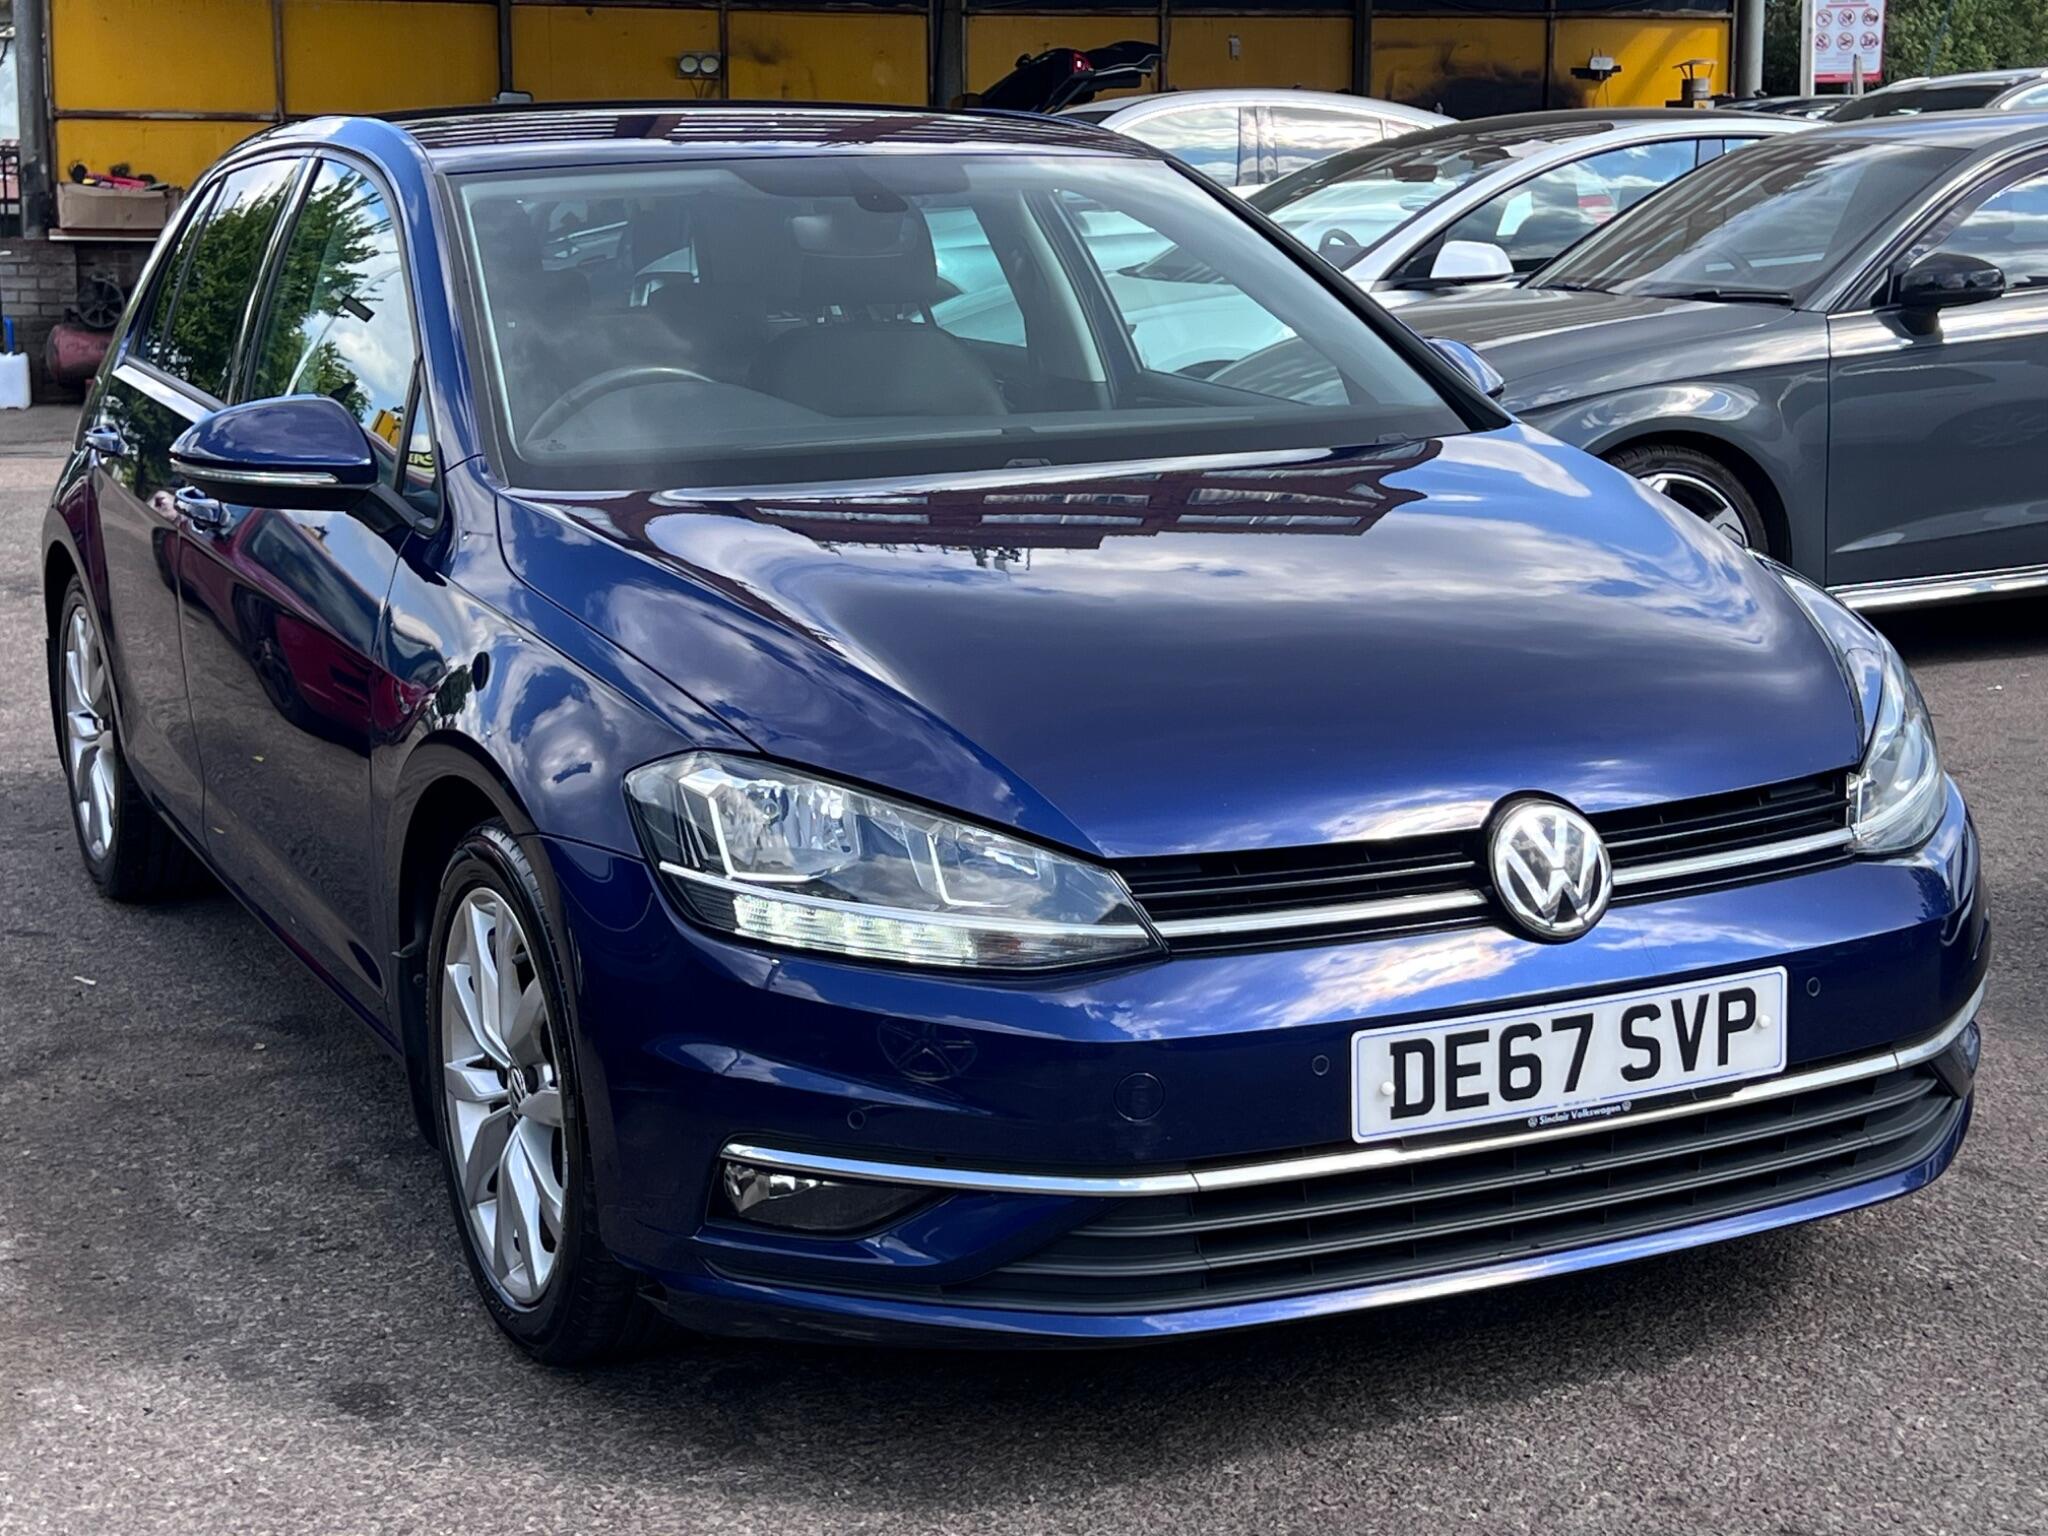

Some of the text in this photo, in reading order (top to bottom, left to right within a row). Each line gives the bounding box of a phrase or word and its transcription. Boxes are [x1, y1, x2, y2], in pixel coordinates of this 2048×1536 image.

[1390, 986, 1757, 1120] DE67 SVP
[1539, 1105, 1621, 1125] Sinclair Volkswagen
